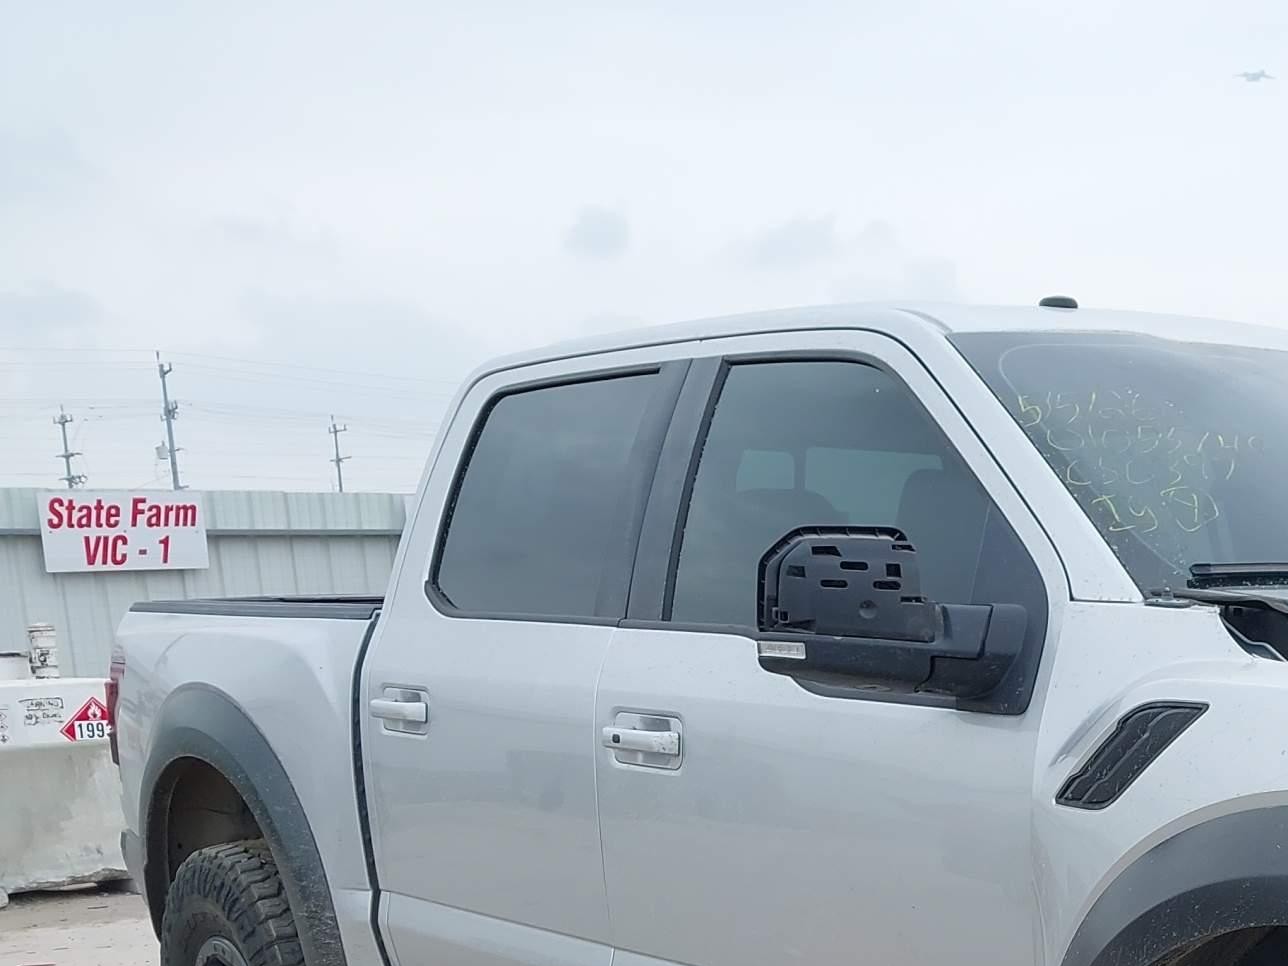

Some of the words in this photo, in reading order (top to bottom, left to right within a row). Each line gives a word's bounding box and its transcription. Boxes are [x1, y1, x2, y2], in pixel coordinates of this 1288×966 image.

[47, 497, 121, 529] State
[131, 497, 197, 528] Farm
[83, 534, 129, 566] VIC
[158, 535, 170, 564] 1
